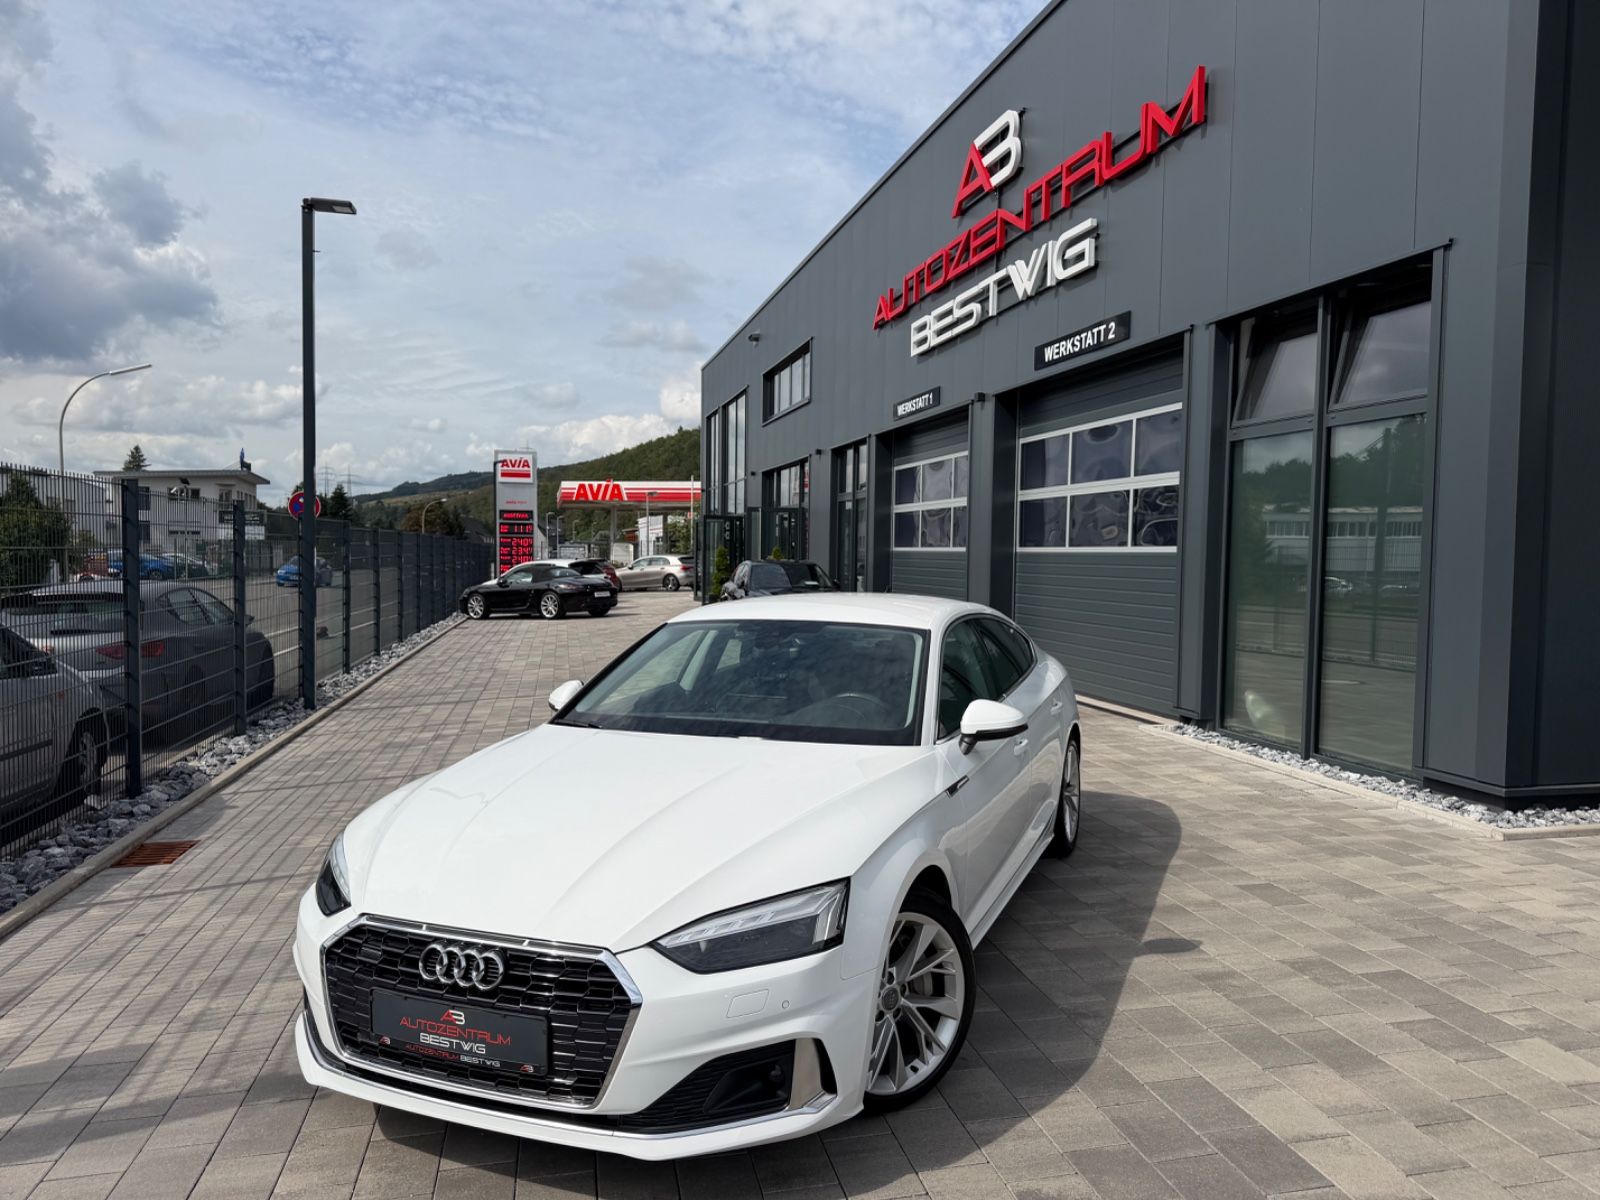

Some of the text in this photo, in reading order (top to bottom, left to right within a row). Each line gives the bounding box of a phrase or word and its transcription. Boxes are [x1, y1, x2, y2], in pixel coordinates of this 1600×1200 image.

[873, 65, 1206, 330] AUTOZENTRUM
[910, 218, 1098, 357] BESTWIG
[1044, 321, 1116, 362] WERKSTATT 2
[897, 397, 929, 417] WERKSTATT
[400, 1016, 512, 1047] AUTOZENTRUM
[420, 1032, 486, 1054] BESTWIG
[405, 1044, 501, 1068] AUTOZENTRUM BESTWIG
